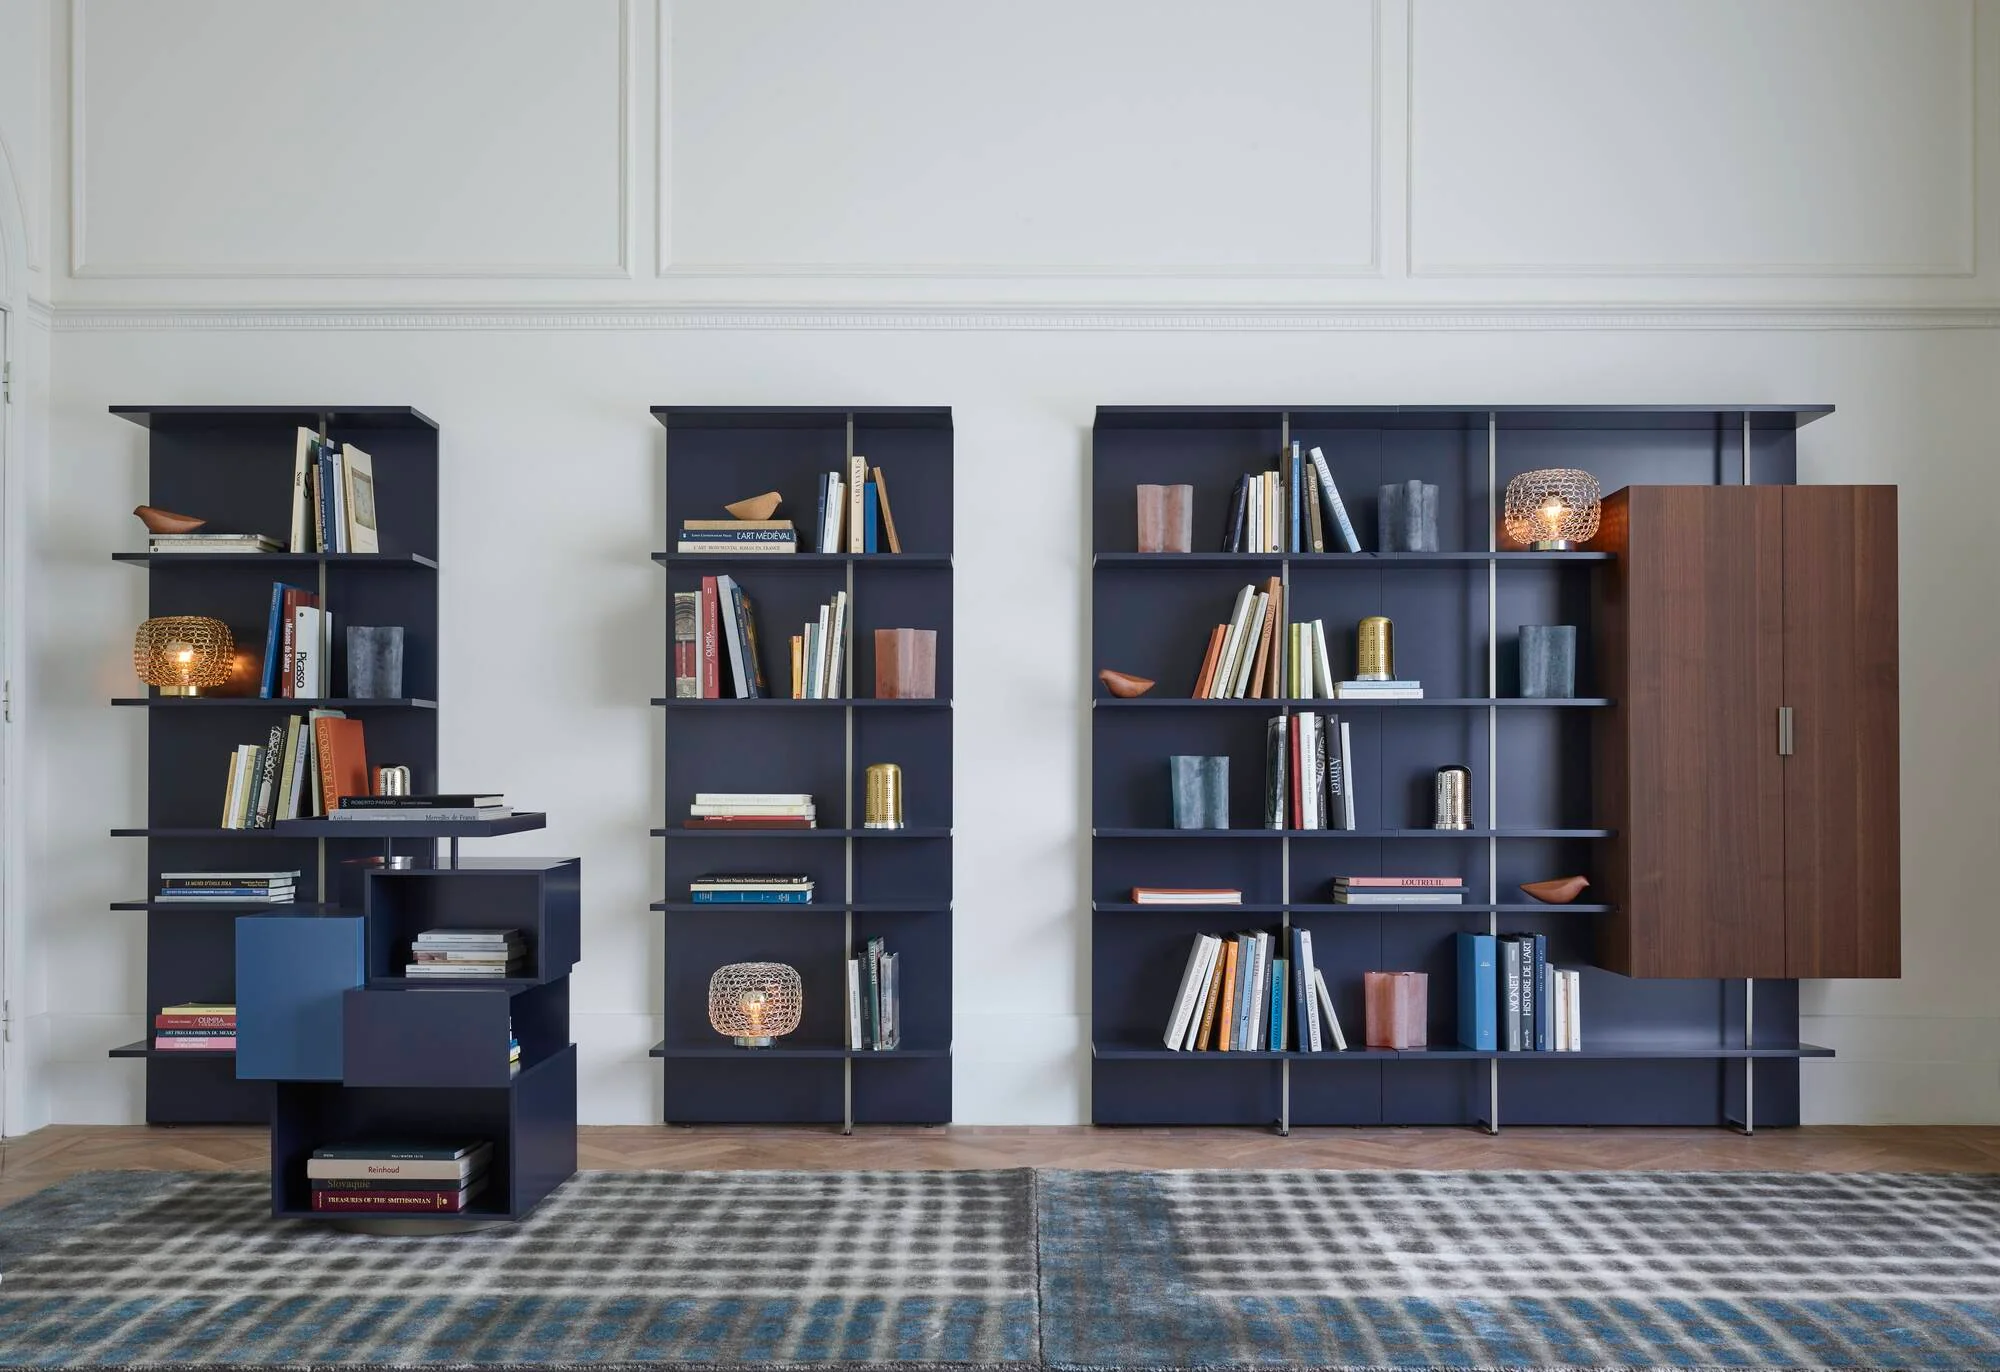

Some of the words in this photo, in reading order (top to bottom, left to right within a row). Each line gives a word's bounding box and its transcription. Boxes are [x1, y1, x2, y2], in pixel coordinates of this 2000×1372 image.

[756, 530, 790, 540] MÉDIÉVAL
[1264, 604, 1276, 638] PICASSO
[284, 623, 293, 645] Maisons
[284, 654, 292, 673] Sahara
[296, 652, 307, 688] Picasso
[319, 726, 332, 769] GEORGES
[322, 770, 333, 784] DE
[325, 785, 334, 796] LA
[1523, 941, 1531, 964] L'ART
[1523, 966, 1531, 977] DE
[1509, 973, 1519, 1012] MONET
[1523, 979, 1531, 1016] HISTOIRE
[327, 1180, 370, 1190] Slovaquie
